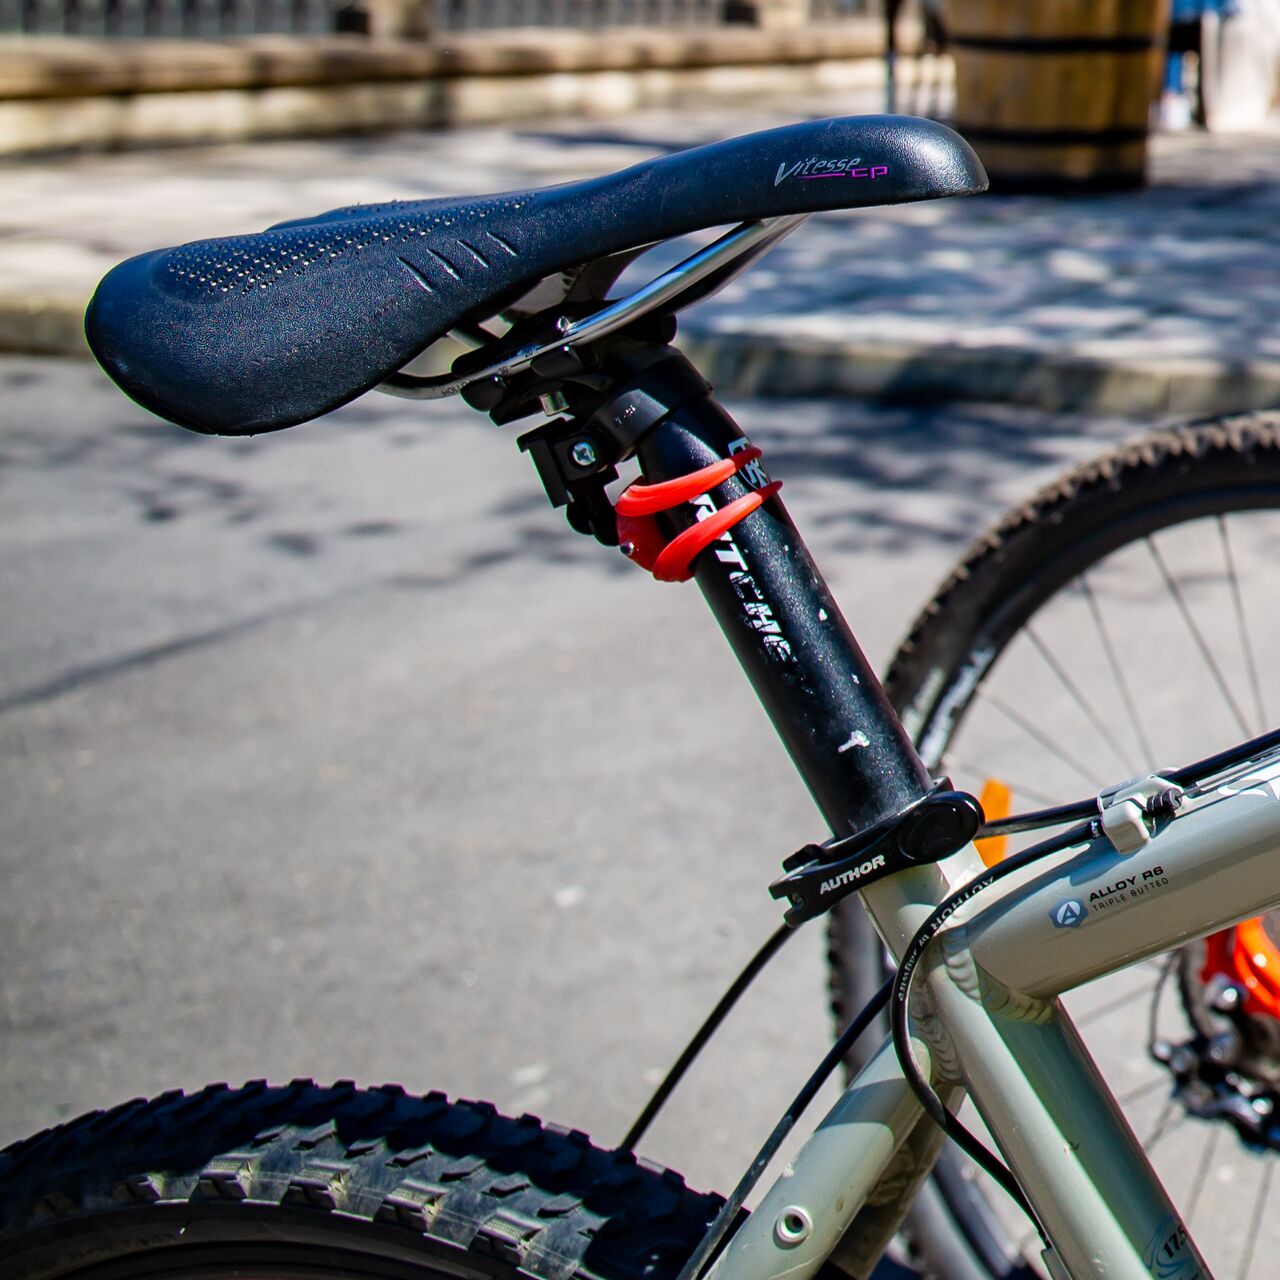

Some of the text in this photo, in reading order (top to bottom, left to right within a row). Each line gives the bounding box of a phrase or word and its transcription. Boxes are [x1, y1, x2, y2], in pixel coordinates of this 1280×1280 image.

[774, 156, 861, 187] Vitesse
[820, 854, 886, 895] AUTHOR
[1089, 865, 1164, 903] ALLOY R6
[1092, 876, 1169, 912] TRIPLE BUTTED
